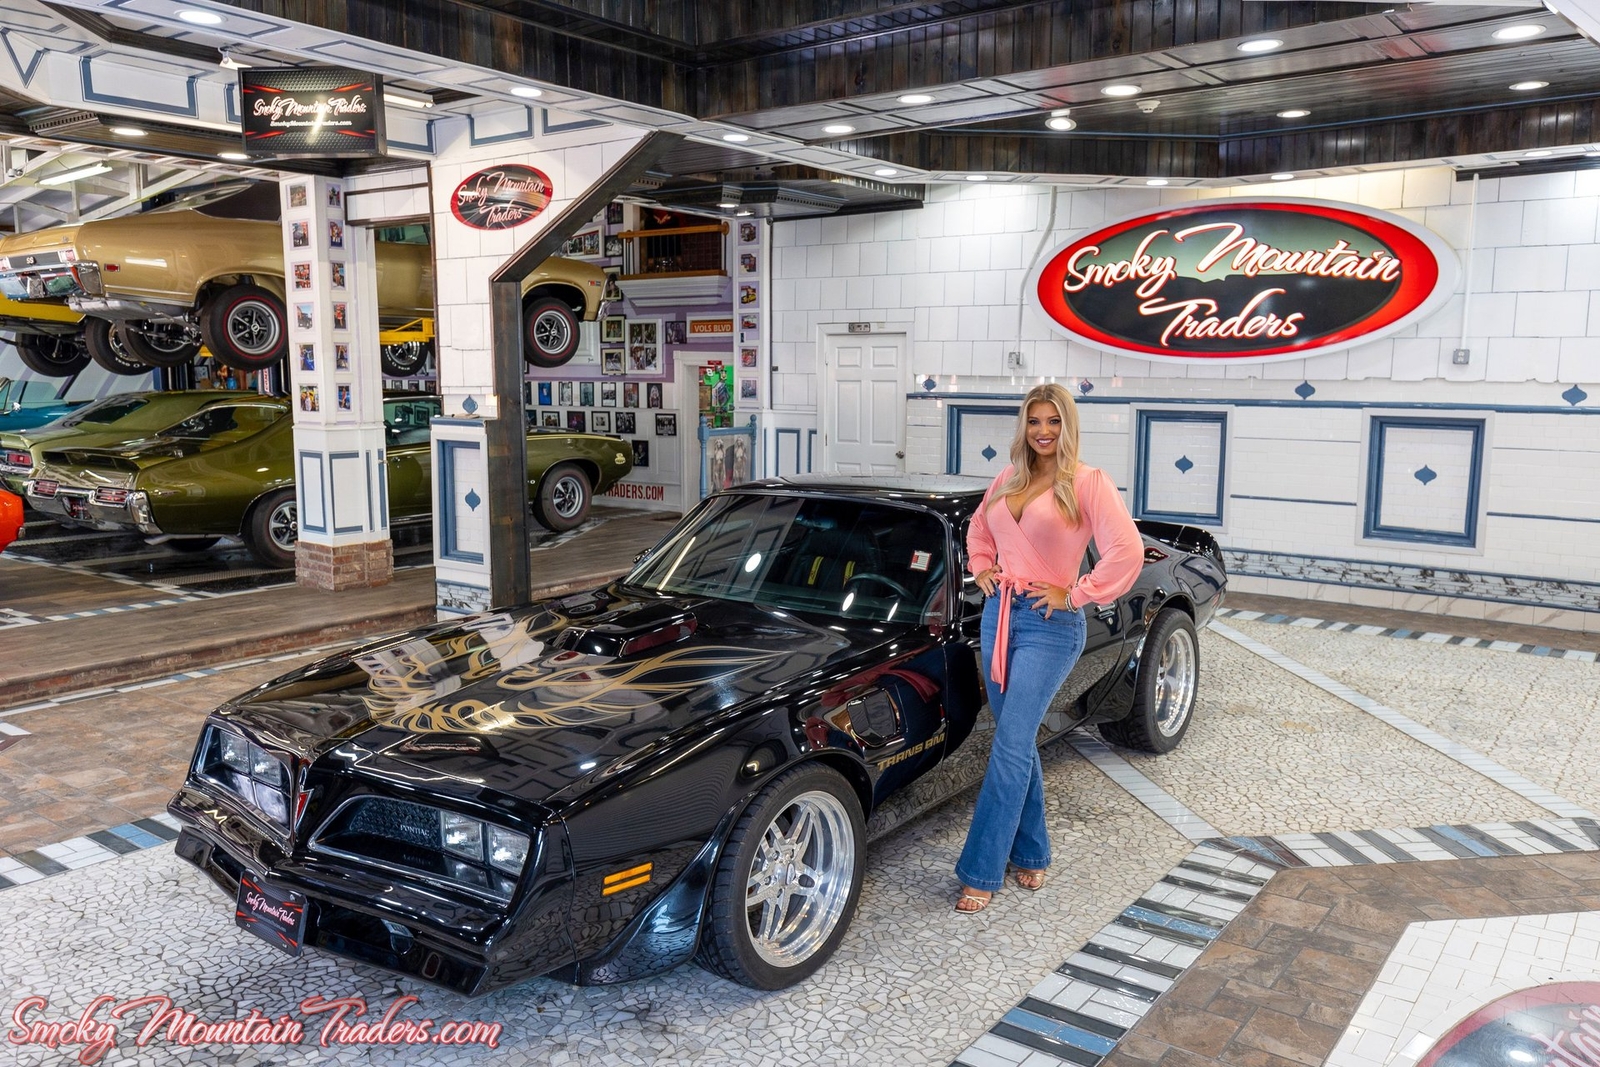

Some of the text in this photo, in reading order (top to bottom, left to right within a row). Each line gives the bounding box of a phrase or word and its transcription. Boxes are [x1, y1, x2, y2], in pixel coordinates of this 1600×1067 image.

[253, 95, 366, 120] Smoky Mountin Traders
[457, 171, 544, 206] Smoky Mountain
[479, 198, 522, 227] Traders
[1063, 222, 1401, 297] Smoky Mountain
[713, 324, 731, 332] BLVD
[1138, 287, 1305, 347] Traders
[604, 483, 664, 501] RADERS.COM
[877, 732, 945, 771] TRANS AM
[400, 824, 430, 837] PONTIAC
